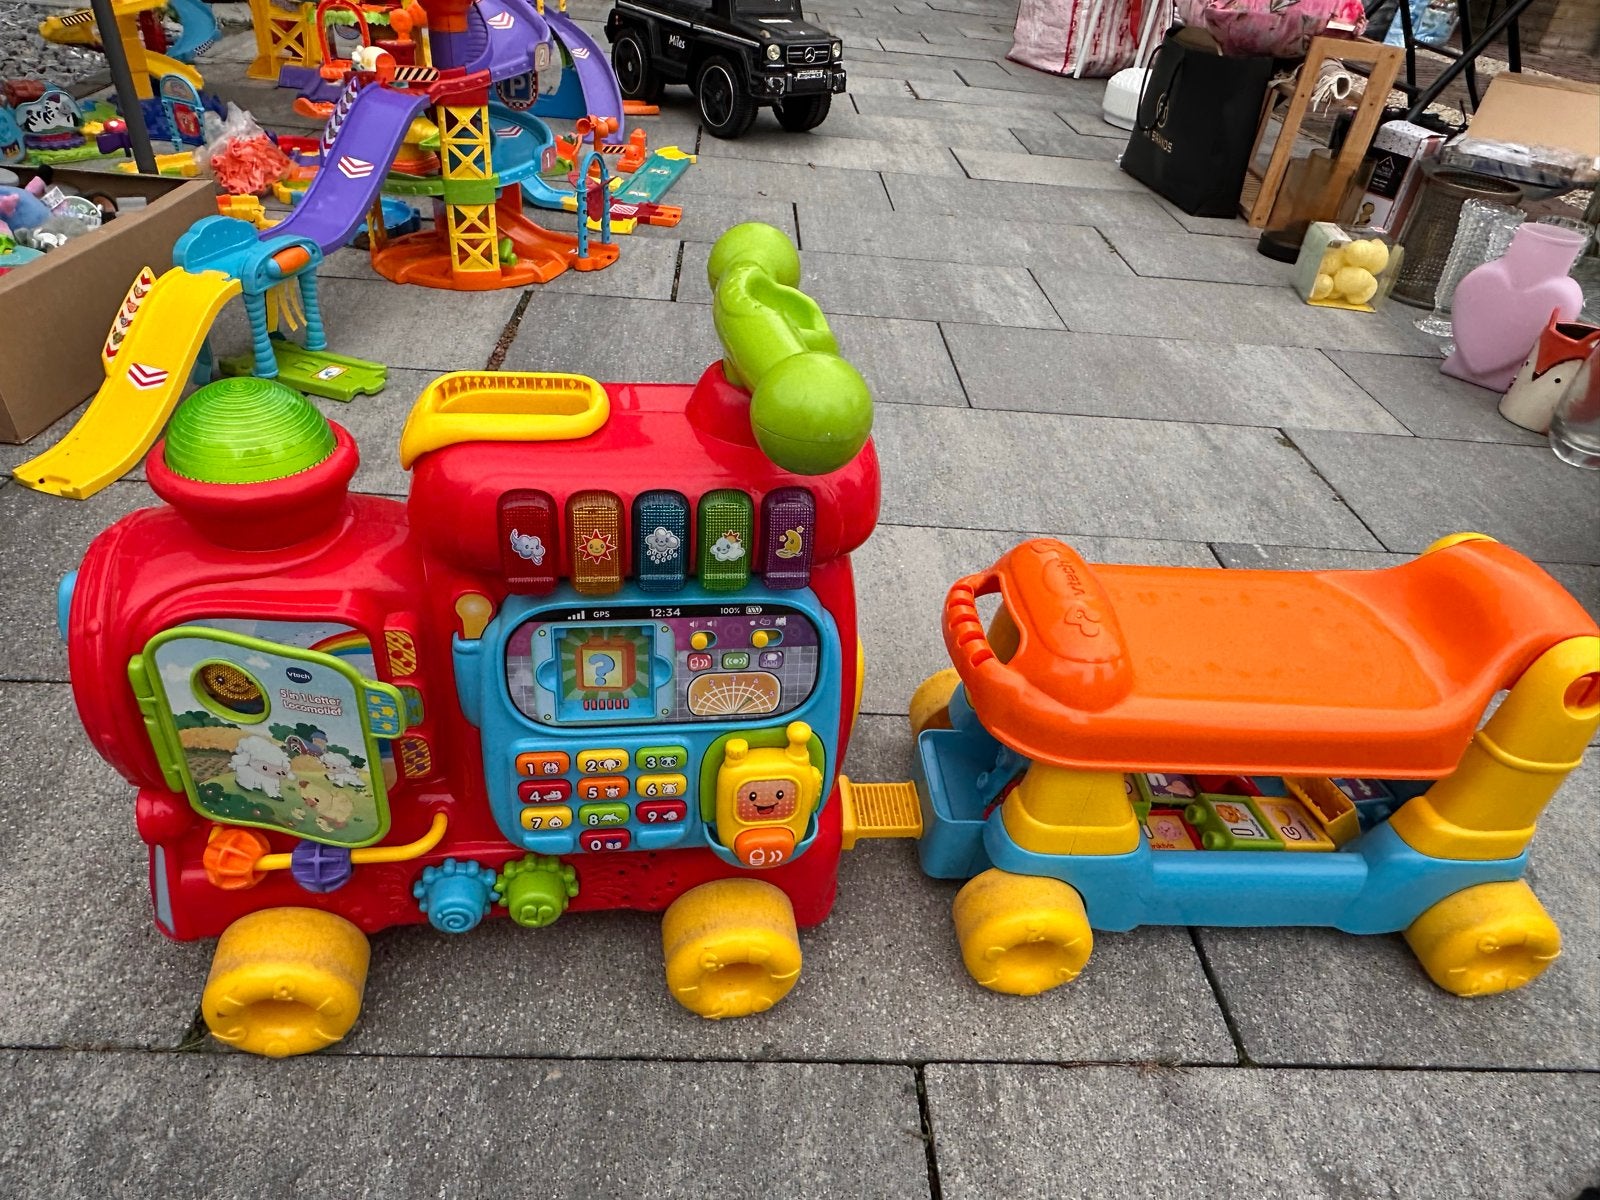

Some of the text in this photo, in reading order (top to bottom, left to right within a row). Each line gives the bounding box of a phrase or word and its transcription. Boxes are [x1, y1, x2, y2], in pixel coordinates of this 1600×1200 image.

[669, 35, 685, 49] Miles
[539, 48, 546, 66] 2
[510, 75, 526, 97] P
[544, 151, 551, 169] 1
[593, 610, 610, 618] GPS
[650, 607, 681, 618] 12:34
[720, 606, 740, 614] 100%
[280, 689, 288, 698] 5
[287, 690, 300, 701] in
[527, 763, 535, 775] 1
[585, 760, 597, 773] 2
[646, 756, 657, 769] 3
[529, 790, 541, 802] 4
[587, 786, 598, 799] 5
[646, 783, 658, 796] 6
[531, 817, 542, 829] 7
[587, 814, 599, 826] 8
[647, 810, 658, 823] 9
[590, 839, 602, 852] 0
